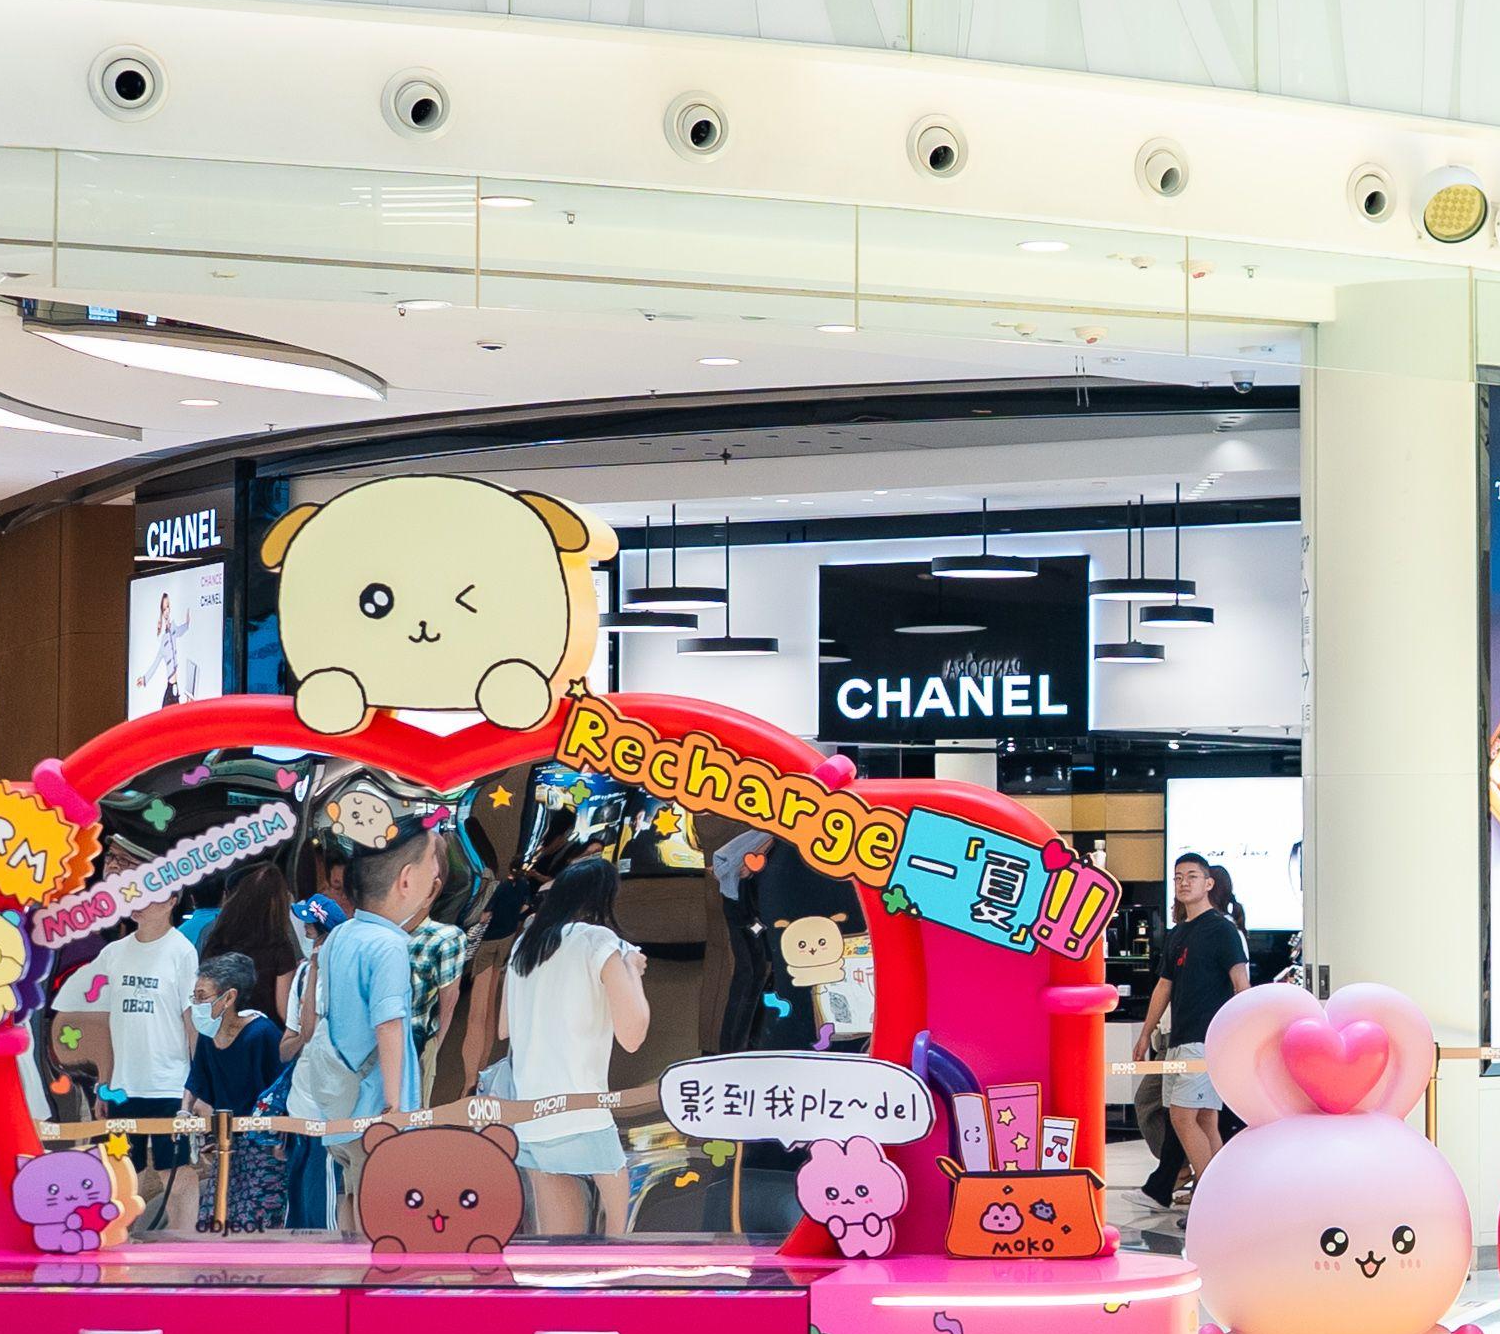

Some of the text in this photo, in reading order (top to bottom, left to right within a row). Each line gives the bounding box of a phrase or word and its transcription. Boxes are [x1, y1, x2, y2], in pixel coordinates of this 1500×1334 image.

[146, 508, 222, 557] CHANEL
[836, 673, 1068, 719] CHANEL
[565, 707, 898, 871] Recharge
[42, 893, 116, 944] MOKO
[143, 811, 288, 893] CHOIGOSIM
